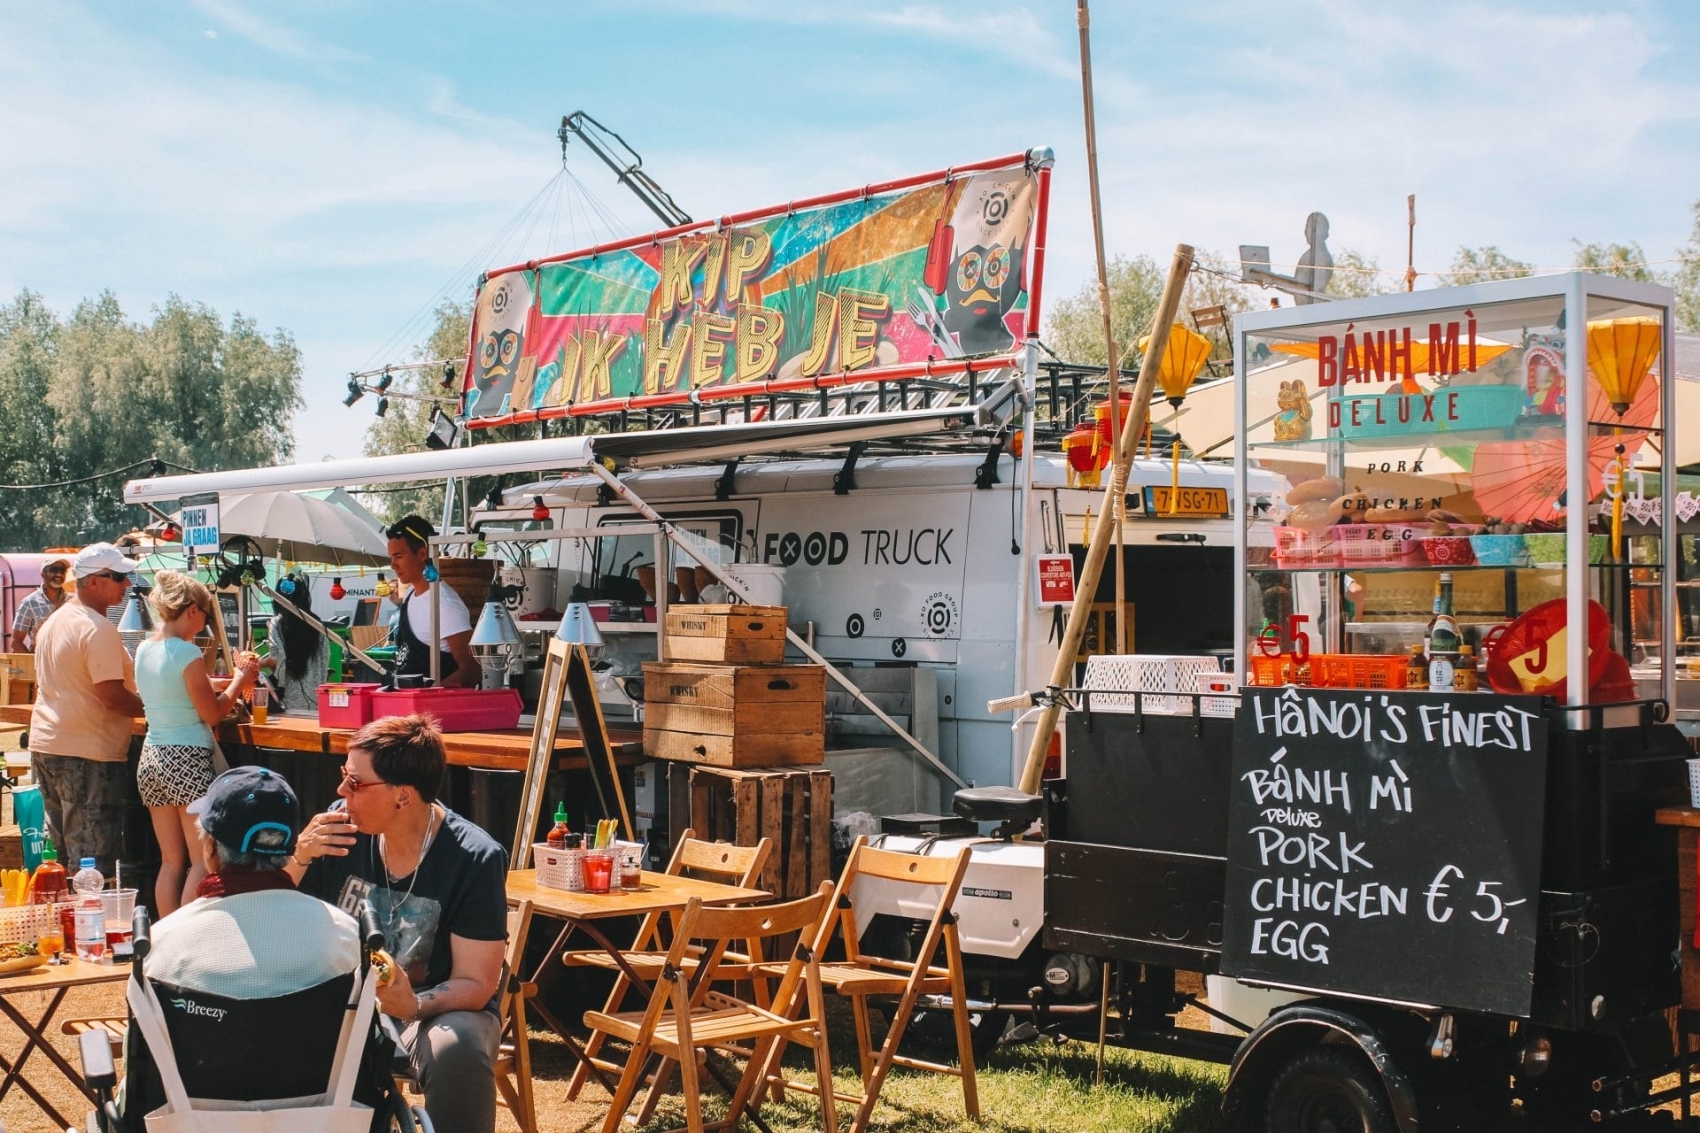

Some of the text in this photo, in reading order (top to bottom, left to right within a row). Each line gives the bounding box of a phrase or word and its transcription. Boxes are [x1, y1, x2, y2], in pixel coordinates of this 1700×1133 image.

[661, 227, 771, 314] KIP
[560, 287, 891, 405] IK HEB JE
[1318, 308, 1477, 387] BÁNH MÌ
[1330, 393, 1459, 428] DELUXE
[1367, 459, 1424, 475] PORK
[1342, 496, 1443, 512] CHICKEN
[183, 509, 207, 527] PINNEN
[184, 527, 217, 547] JA GRAAG
[1367, 529, 1414, 542] EGG
[764, 528, 954, 567] FOOD TRUCK
[681, 620, 707, 631] WHISKY
[669, 684, 700, 699] WHISKY
[975, 890, 998, 898] apollo
[1251, 917, 1330, 965] EGG
[187, 1000, 225, 1022] Breezy
